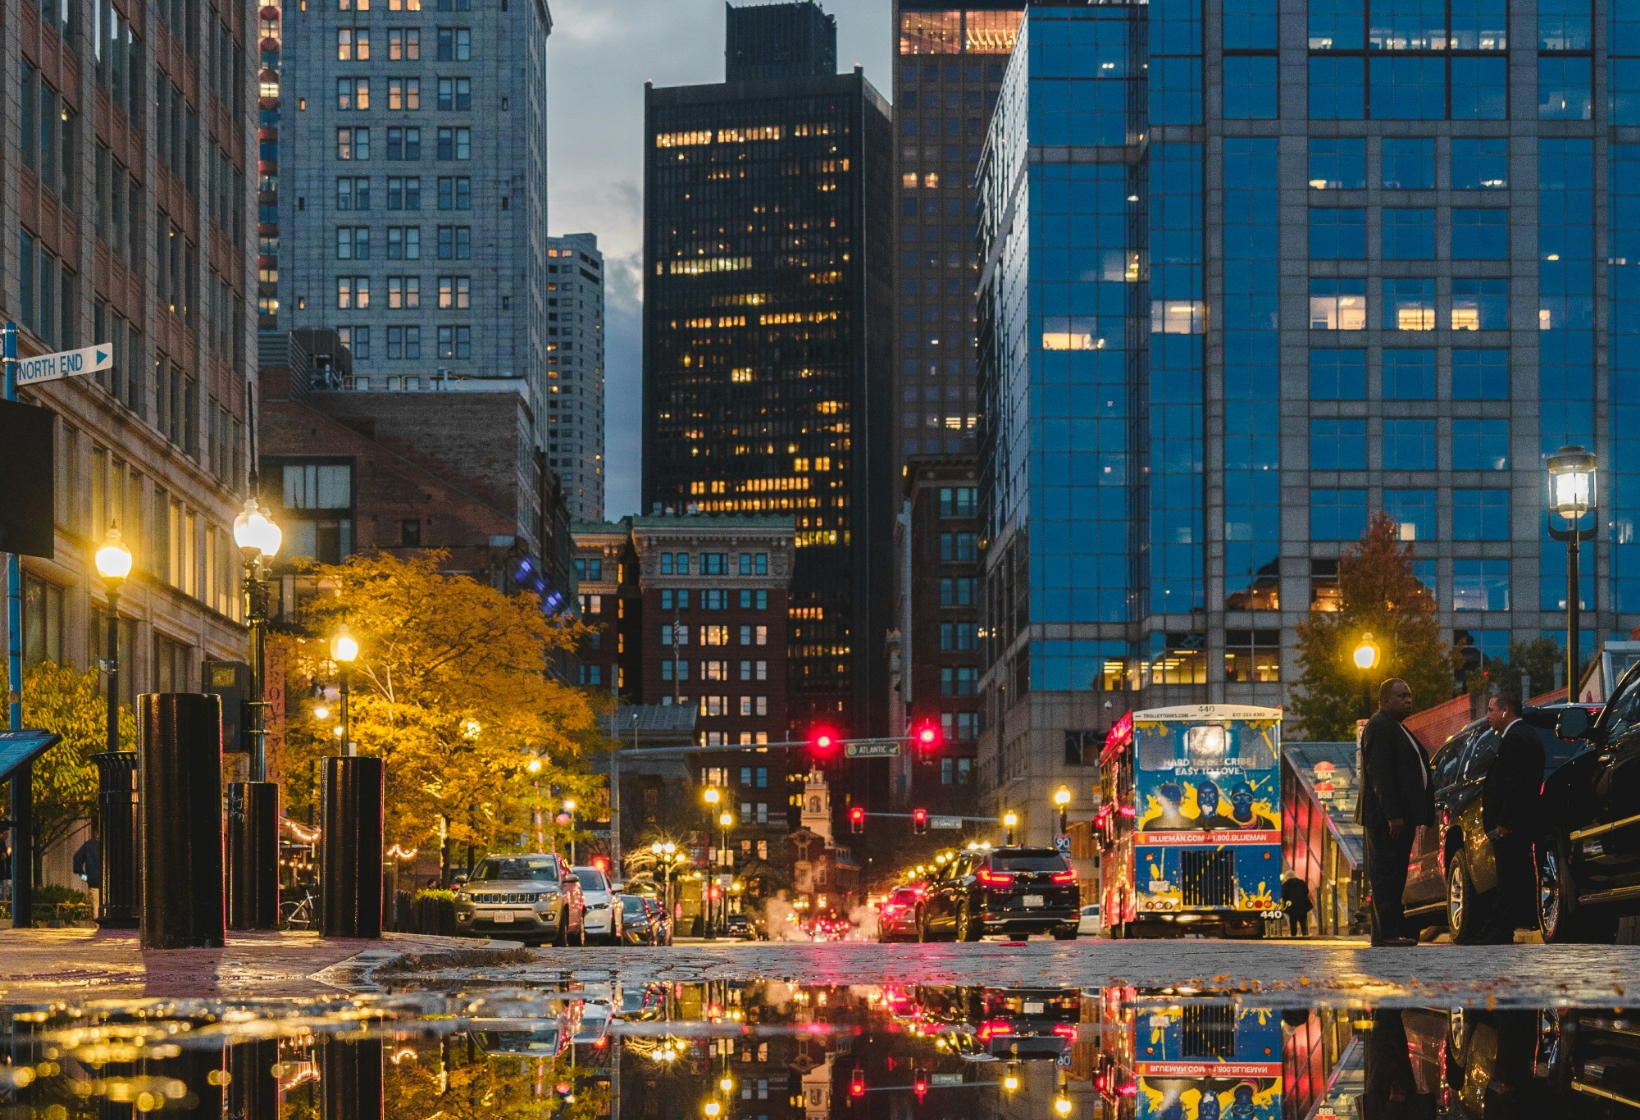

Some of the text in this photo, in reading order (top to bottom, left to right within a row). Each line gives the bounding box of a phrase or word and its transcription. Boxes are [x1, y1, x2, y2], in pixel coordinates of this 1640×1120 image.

[18, 353, 83, 381] NORTH END
[1198, 705, 1215, 713] 440
[859, 745, 887, 754] ATLANTIC
[1163, 758, 1190, 767] HARD
[1175, 766, 1198, 776] EASY
[1056, 837, 1070, 848] 90
[1149, 833, 1267, 843] BLUEMAN.COM 1.800.BLUEMAN
[1260, 910, 1282, 919] 440
